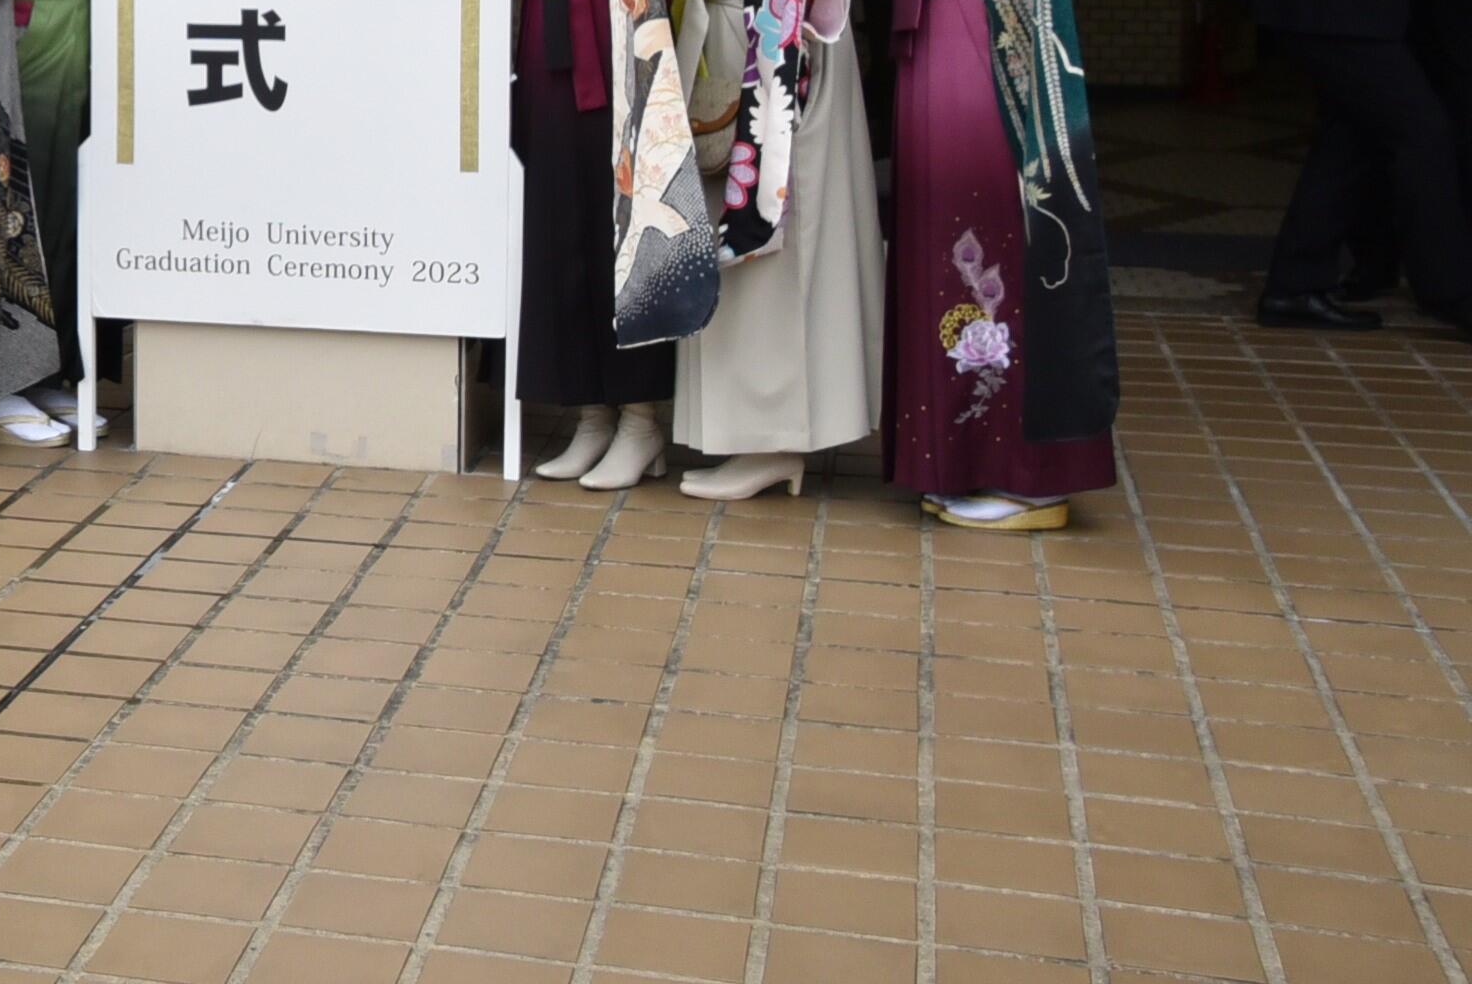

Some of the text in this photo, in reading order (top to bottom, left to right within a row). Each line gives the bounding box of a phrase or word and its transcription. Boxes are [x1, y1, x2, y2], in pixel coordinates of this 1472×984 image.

[181, 219, 395, 254] Meijo University
[115, 248, 481, 287] Graduation Ceremony 2023
